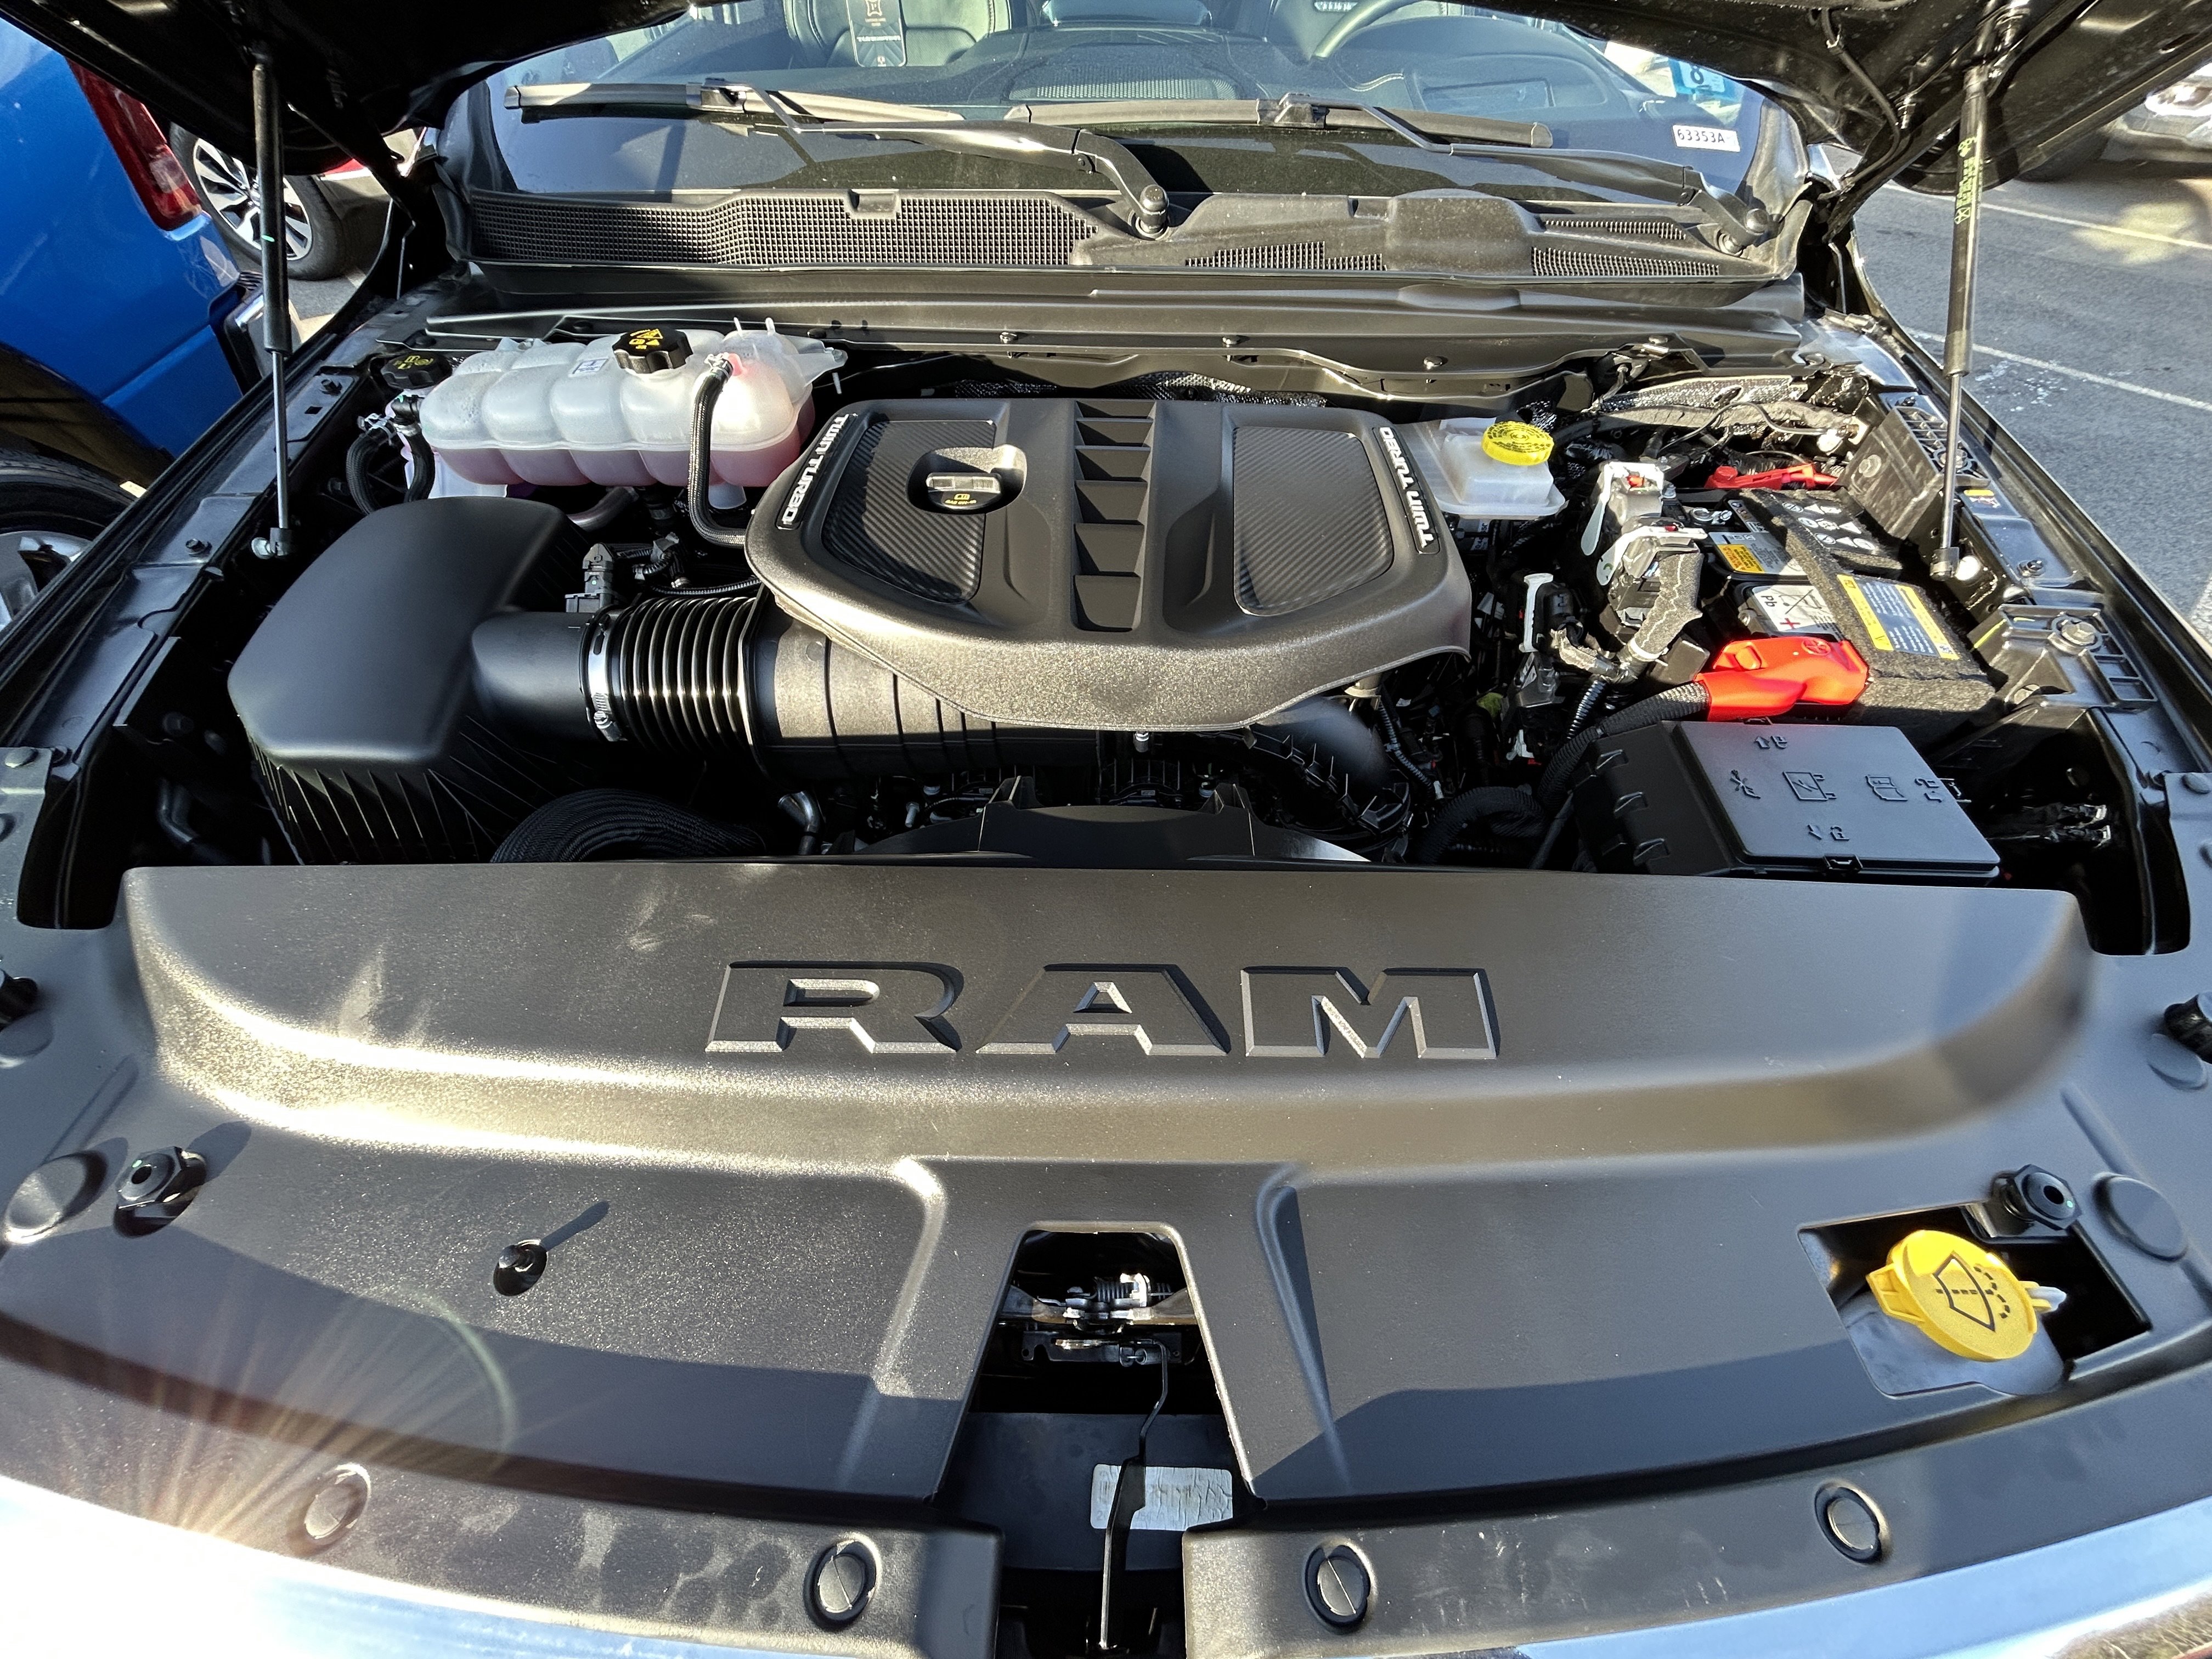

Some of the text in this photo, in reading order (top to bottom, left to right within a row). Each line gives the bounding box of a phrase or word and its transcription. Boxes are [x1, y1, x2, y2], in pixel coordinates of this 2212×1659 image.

[1677, 128, 1725, 143] 63353A
[781, 413, 849, 525] TWIN TURBO
[1379, 426, 1434, 549] TWIN TURBO
[1760, 595, 1778, 607] Pb
[704, 960, 1498, 1059] RAM
